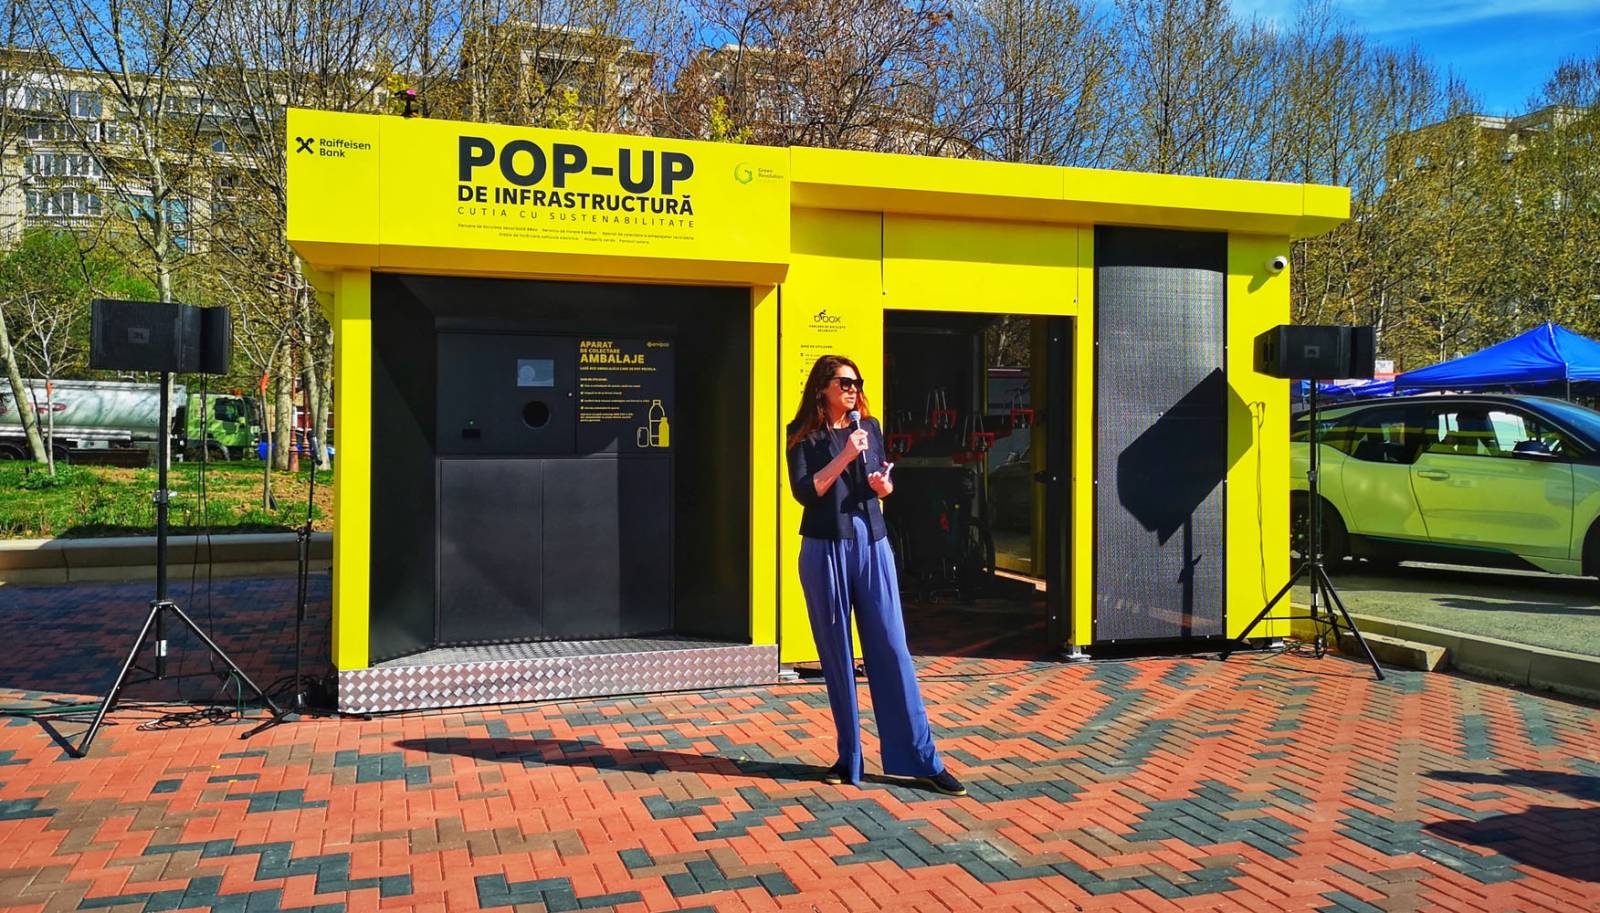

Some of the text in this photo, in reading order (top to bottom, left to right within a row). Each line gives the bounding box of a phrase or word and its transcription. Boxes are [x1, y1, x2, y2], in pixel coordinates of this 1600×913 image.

[319, 138, 371, 150] Raiffeisen
[319, 147, 345, 158] Bank
[458, 135, 695, 195] POP-UP
[458, 184, 694, 216] DE INFRASTRUCTURĂ
[458, 206, 507, 217] CUTIA
[519, 210, 538, 219] CU
[549, 212, 695, 228] SUSTENABILITATE
[580, 354, 645, 363] AMBALAJE
